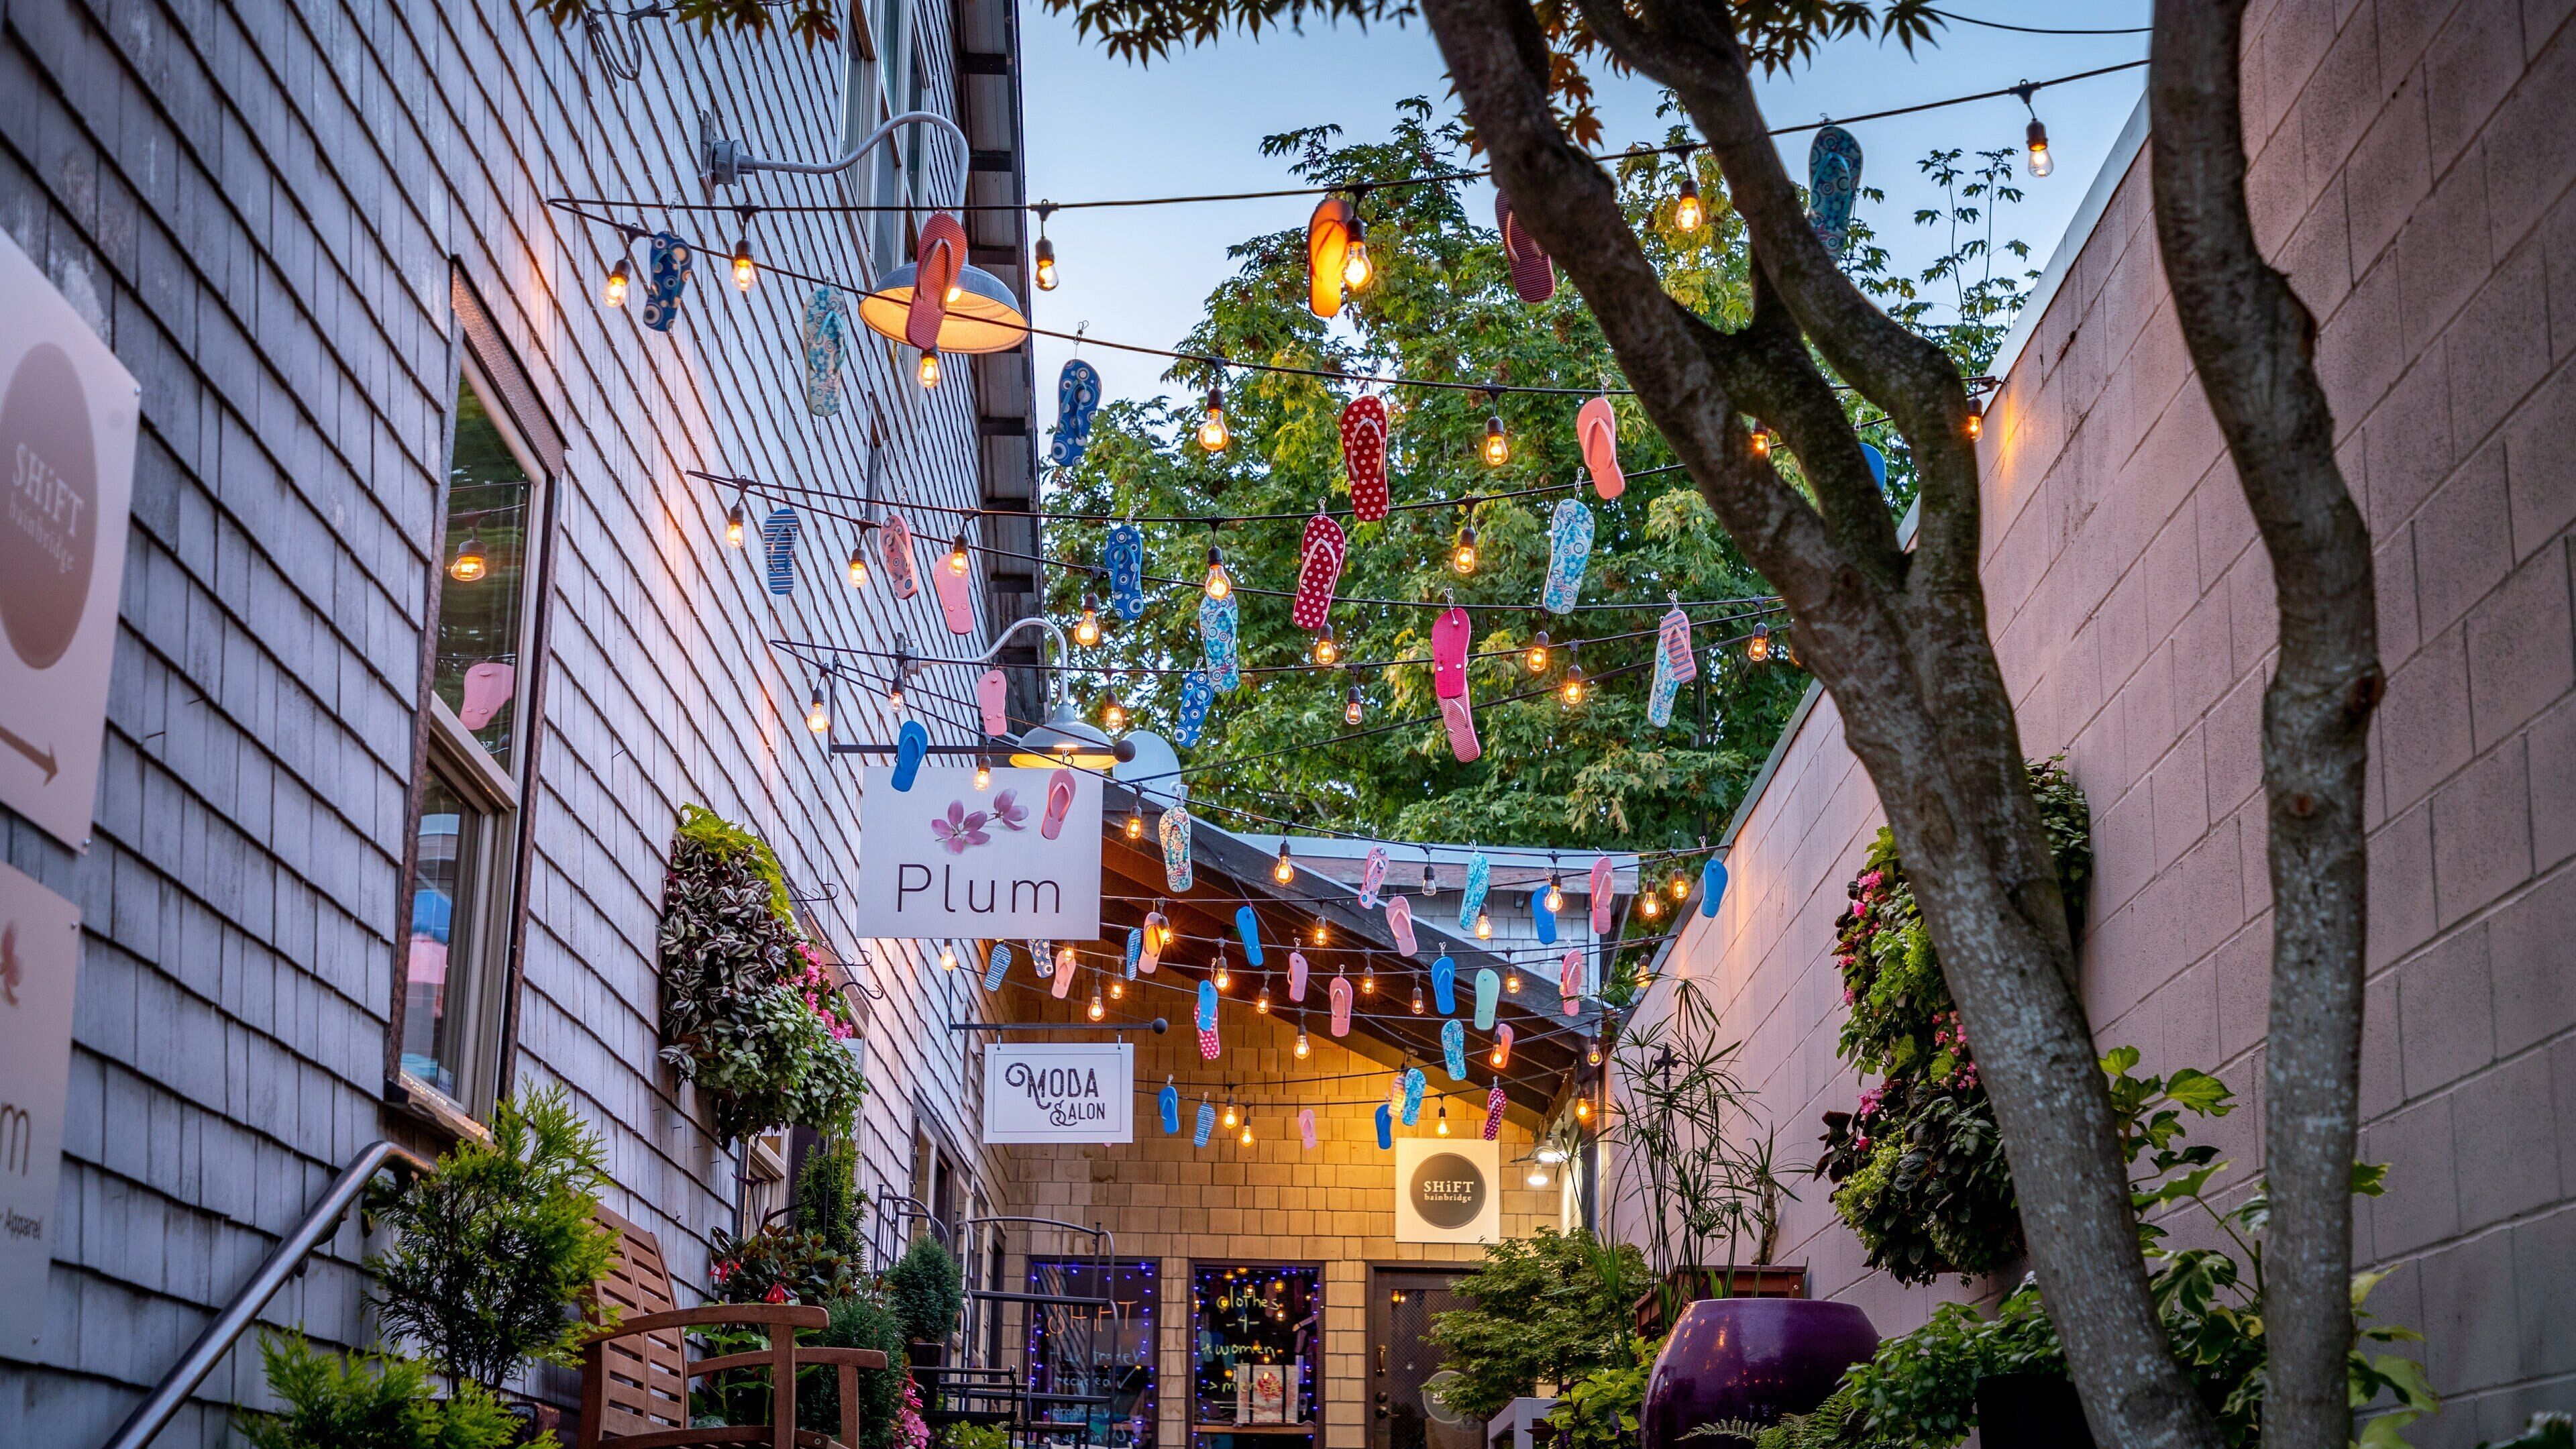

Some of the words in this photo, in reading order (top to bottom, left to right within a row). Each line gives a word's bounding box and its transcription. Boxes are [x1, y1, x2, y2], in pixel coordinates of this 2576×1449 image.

[13, 443, 85, 537] SHiFT
[897, 863, 1060, 914] Plum
[1005, 1062, 1099, 1110] MODA
[1049, 1099, 1106, 1126] SALON
[1423, 1181, 1474, 1193] SHiFT
[1424, 1193, 1472, 1203] bainbridge
[1216, 1285, 1281, 1310] clothes
